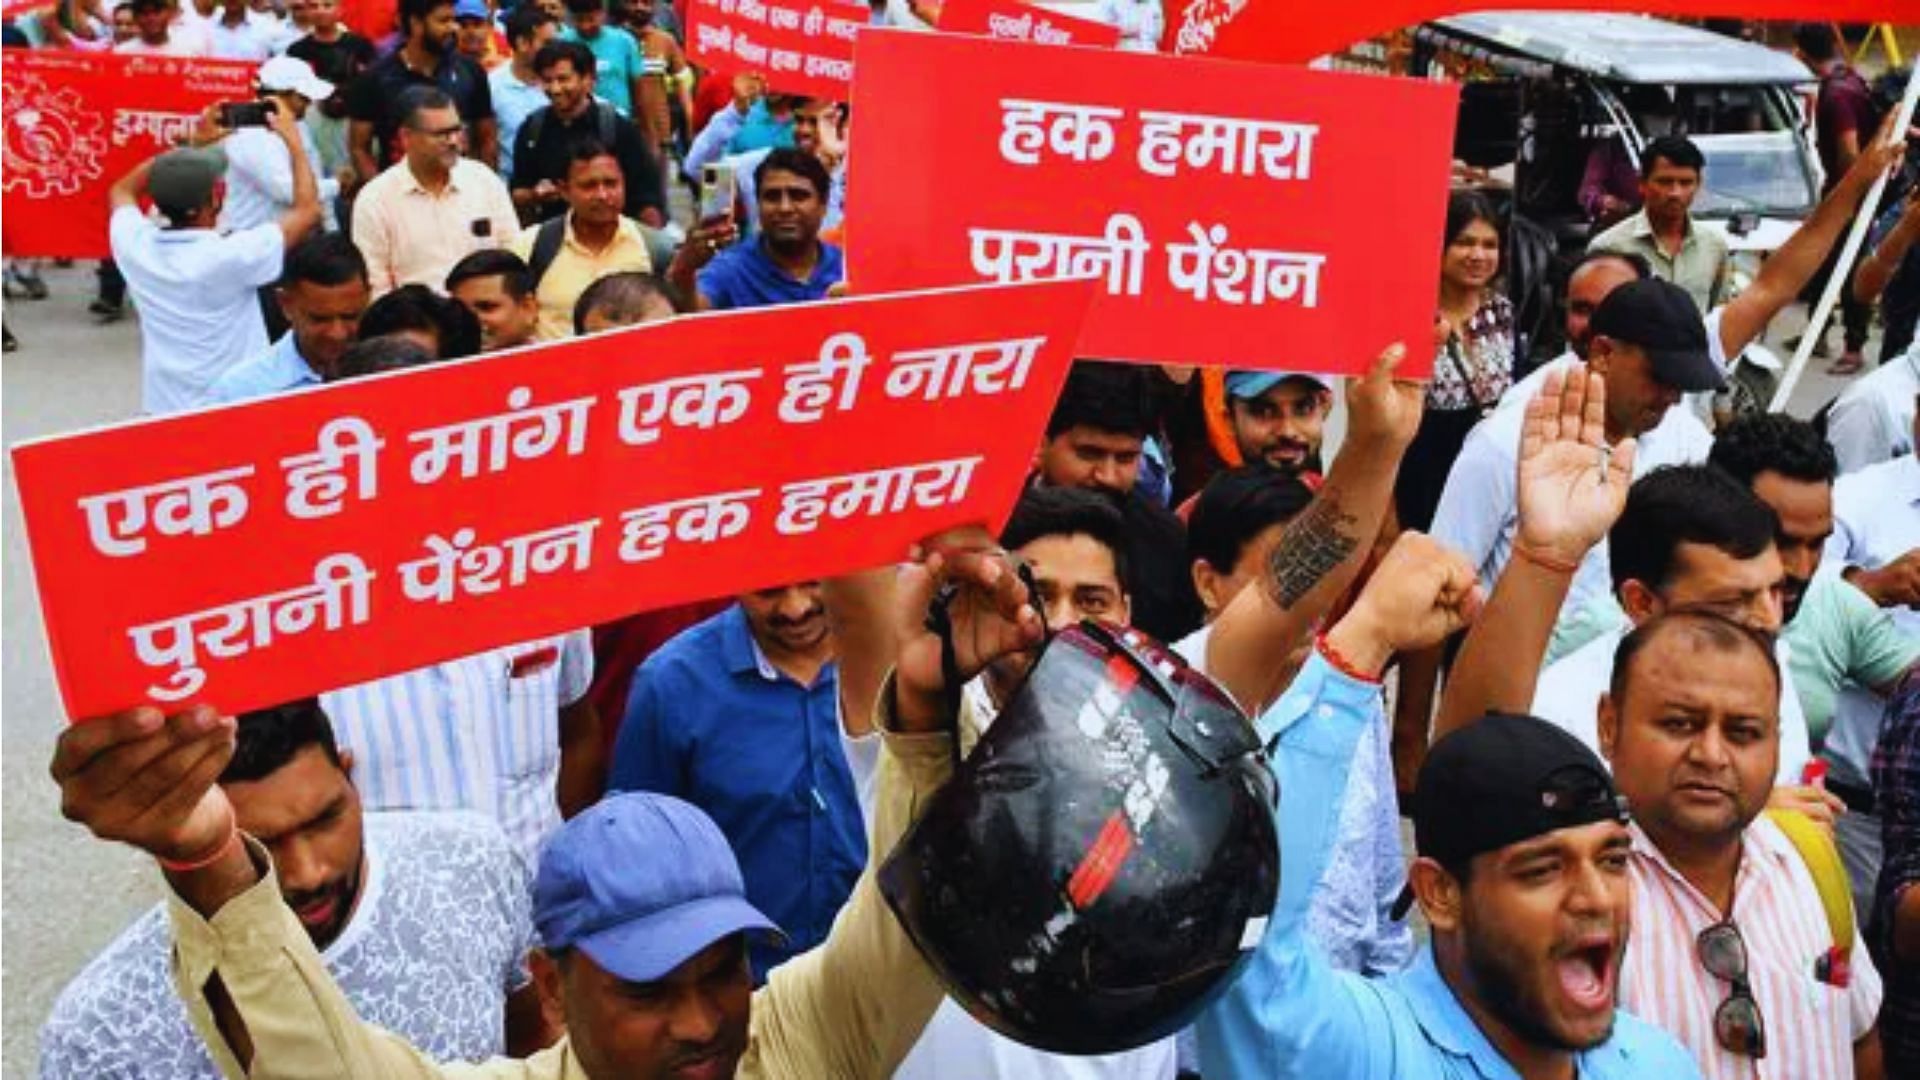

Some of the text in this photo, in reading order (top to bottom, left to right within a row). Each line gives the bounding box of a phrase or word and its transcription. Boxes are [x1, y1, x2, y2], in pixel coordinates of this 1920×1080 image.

[999, 98, 1320, 180] हक हमारा
[1165, 221, 1327, 308] पेंशन
[78, 332, 1048, 557] एक ही मांग एक ही नारा
[128, 456, 984, 701] पुरानी पेंशन हक हमारा
